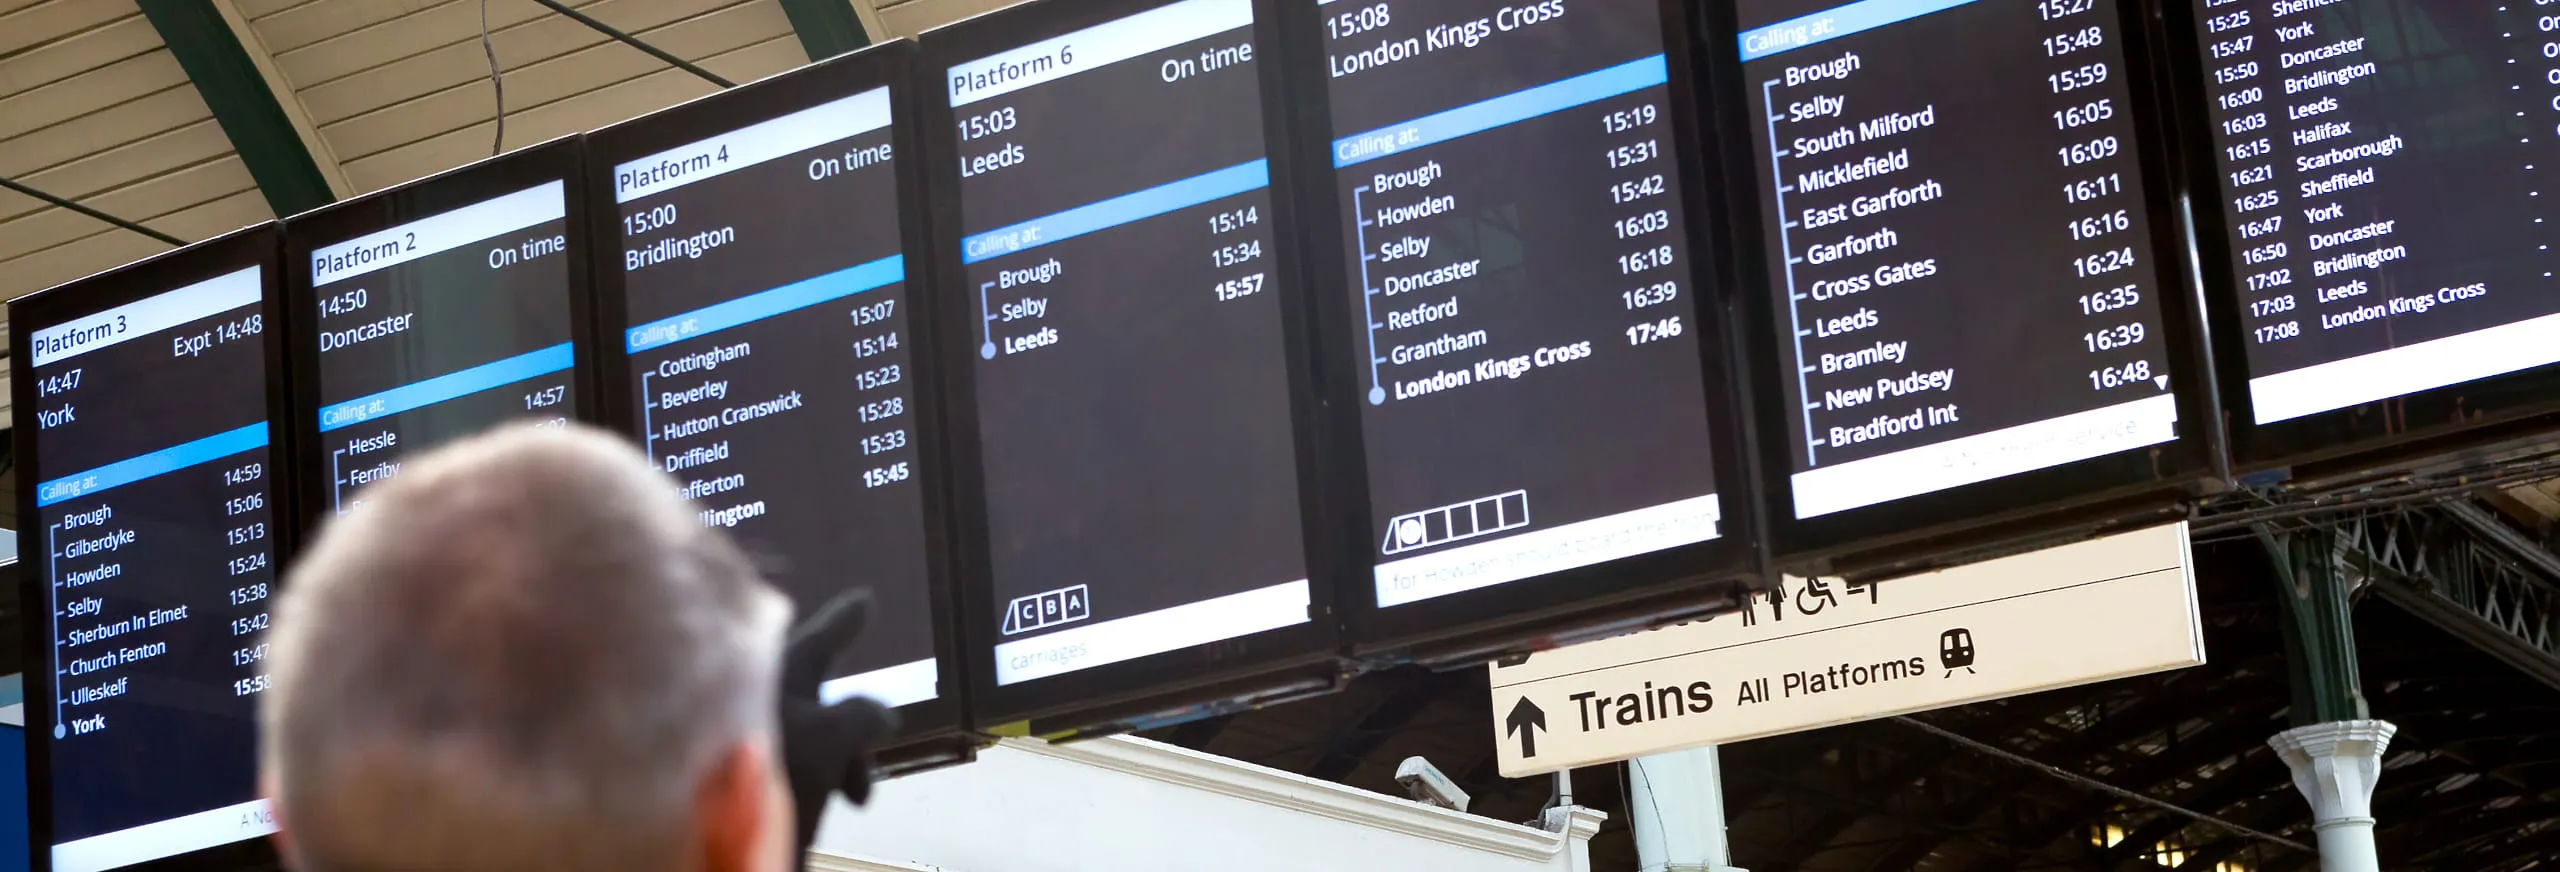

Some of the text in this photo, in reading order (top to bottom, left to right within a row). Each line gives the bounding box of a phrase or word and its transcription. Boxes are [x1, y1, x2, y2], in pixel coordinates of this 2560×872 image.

[1326, 3, 1391, 40] 15:08
[2206, 10, 2251, 34] 15:25
[1330, 0, 1565, 78] London Kings Cross
[1744, 24, 1809, 54] Calling
[2043, 25, 2103, 58] 15:48
[2210, 22, 2314, 59] 15:47 York
[953, 45, 1073, 96] Platform 6
[1161, 43, 1253, 83] On time
[1785, 52, 1861, 88] Brough
[2214, 36, 2365, 84] 15:50 Doncaster
[2047, 63, 2108, 95] 15:59
[2218, 61, 2376, 110] 16:00 Bridlington
[958, 106, 1017, 141] 15:03
[1602, 104, 1657, 134] 15:19
[1789, 94, 1845, 124] Selby
[2052, 99, 2114, 131] 16:05
[2222, 97, 2338, 136] 16:03 Leeds
[1337, 133, 1396, 161] Calling
[1794, 105, 1935, 159] South Milford
[2226, 121, 2352, 162] 16:15 Halifax
[808, 143, 893, 181] On time
[960, 143, 1025, 178] Leeds
[1606, 140, 1659, 169] 15:31
[2058, 135, 2119, 168] 16:09
[2230, 134, 2403, 188] 16:21 Scarborough
[619, 144, 729, 193] Platform 4
[1374, 161, 1442, 194] Brough
[1799, 149, 1909, 194] Micklefield
[1610, 175, 1665, 204] 15:42
[1803, 179, 1943, 230] East Garforth
[2063, 173, 2122, 205] 16:11
[2234, 167, 2375, 213] 16:25 Sheffield
[624, 203, 677, 236] 15:00
[1209, 206, 1259, 235] 15:14
[1377, 193, 1455, 228] Howden
[1614, 210, 1669, 240] 16:03
[2068, 209, 2129, 242] 16:16
[2238, 203, 2344, 239] 16:47 York
[315, 232, 417, 276] Platform 2
[489, 234, 565, 269] On time
[625, 225, 735, 271] Bridlington
[966, 226, 1042, 258] Calling at:
[1212, 240, 1262, 269] 15:34
[1380, 235, 1431, 263] Selby
[1807, 227, 1898, 266] Garforth
[2242, 219, 2395, 265] 16:50 Doncaster
[999, 257, 1062, 289] Brough
[1617, 245, 1673, 275] 16:18
[2073, 247, 2135, 278] 16:24
[2246, 245, 2406, 292] 17:02 Bridlington
[1214, 273, 1265, 302] 15:57
[1384, 257, 1480, 297] Doncaster
[1811, 258, 1937, 302] Cross Gates
[319, 288, 367, 319] 14:50
[1001, 298, 1048, 323] Selby
[1622, 280, 1677, 311] 16:39
[2079, 285, 2140, 316] 16:35
[2250, 280, 2368, 318] 17:03 Leeds
[850, 300, 895, 327] 15:07
[1388, 297, 1459, 332] Retford
[1816, 307, 1879, 338] Leeds
[2254, 282, 2487, 344] 17:08 London Kings Cross
[35, 315, 127, 357] Platform 3
[174, 314, 263, 357] Expt 14:48
[319, 311, 414, 352] Doncaster
[629, 317, 698, 347] Calling at:
[853, 332, 899, 359] 15:14
[1004, 327, 1059, 355] Leeds
[1391, 327, 1488, 367] Grantham
[1625, 316, 1683, 346] 17:46
[2083, 322, 2145, 353] 16:39
[659, 341, 751, 378] Cottingham
[1394, 340, 1592, 401] London Kings Cross
[1820, 340, 1908, 375] Bramley
[37, 368, 82, 398] 14:47
[855, 365, 901, 392] 15:23
[1825, 368, 1955, 412] New Pudsey
[2089, 360, 2151, 391] 16:48
[524, 385, 565, 411] 14:57
[661, 379, 728, 410] Beverley
[858, 397, 904, 424] 15:28
[37, 403, 75, 429] York
[323, 398, 386, 426] Calling at:
[663, 391, 802, 441] Hutton Cranswick
[1829, 410, 1924, 449] Bradford
[1928, 402, 1960, 427] Int
[349, 431, 396, 456] Hessle
[666, 441, 729, 473] Driffield
[860, 429, 906, 456] 15:33
[40, 475, 98, 501] Calling at:
[224, 463, 262, 487] 14:59
[862, 462, 909, 489] 15:45
[64, 503, 112, 529] Brough
[225, 493, 263, 516] 15:06
[65, 528, 135, 559] Gilberdyke
[226, 523, 264, 546] 15:13
[66, 562, 121, 588] Howden
[228, 552, 266, 576] 15:24
[67, 596, 102, 619] Selby
[229, 582, 268, 606] 15:38
[1023, 594, 1081, 620] C B A
[69, 605, 188, 647] Sherburn In Elmet
[231, 612, 269, 636] 15:42
[70, 641, 166, 676] Church Fenton
[1010, 641, 1088, 670] carriages
[71, 677, 128, 706] Ulleskelf
[1570, 652, 1926, 734] Trains All Platforms
[72, 714, 106, 736] York
